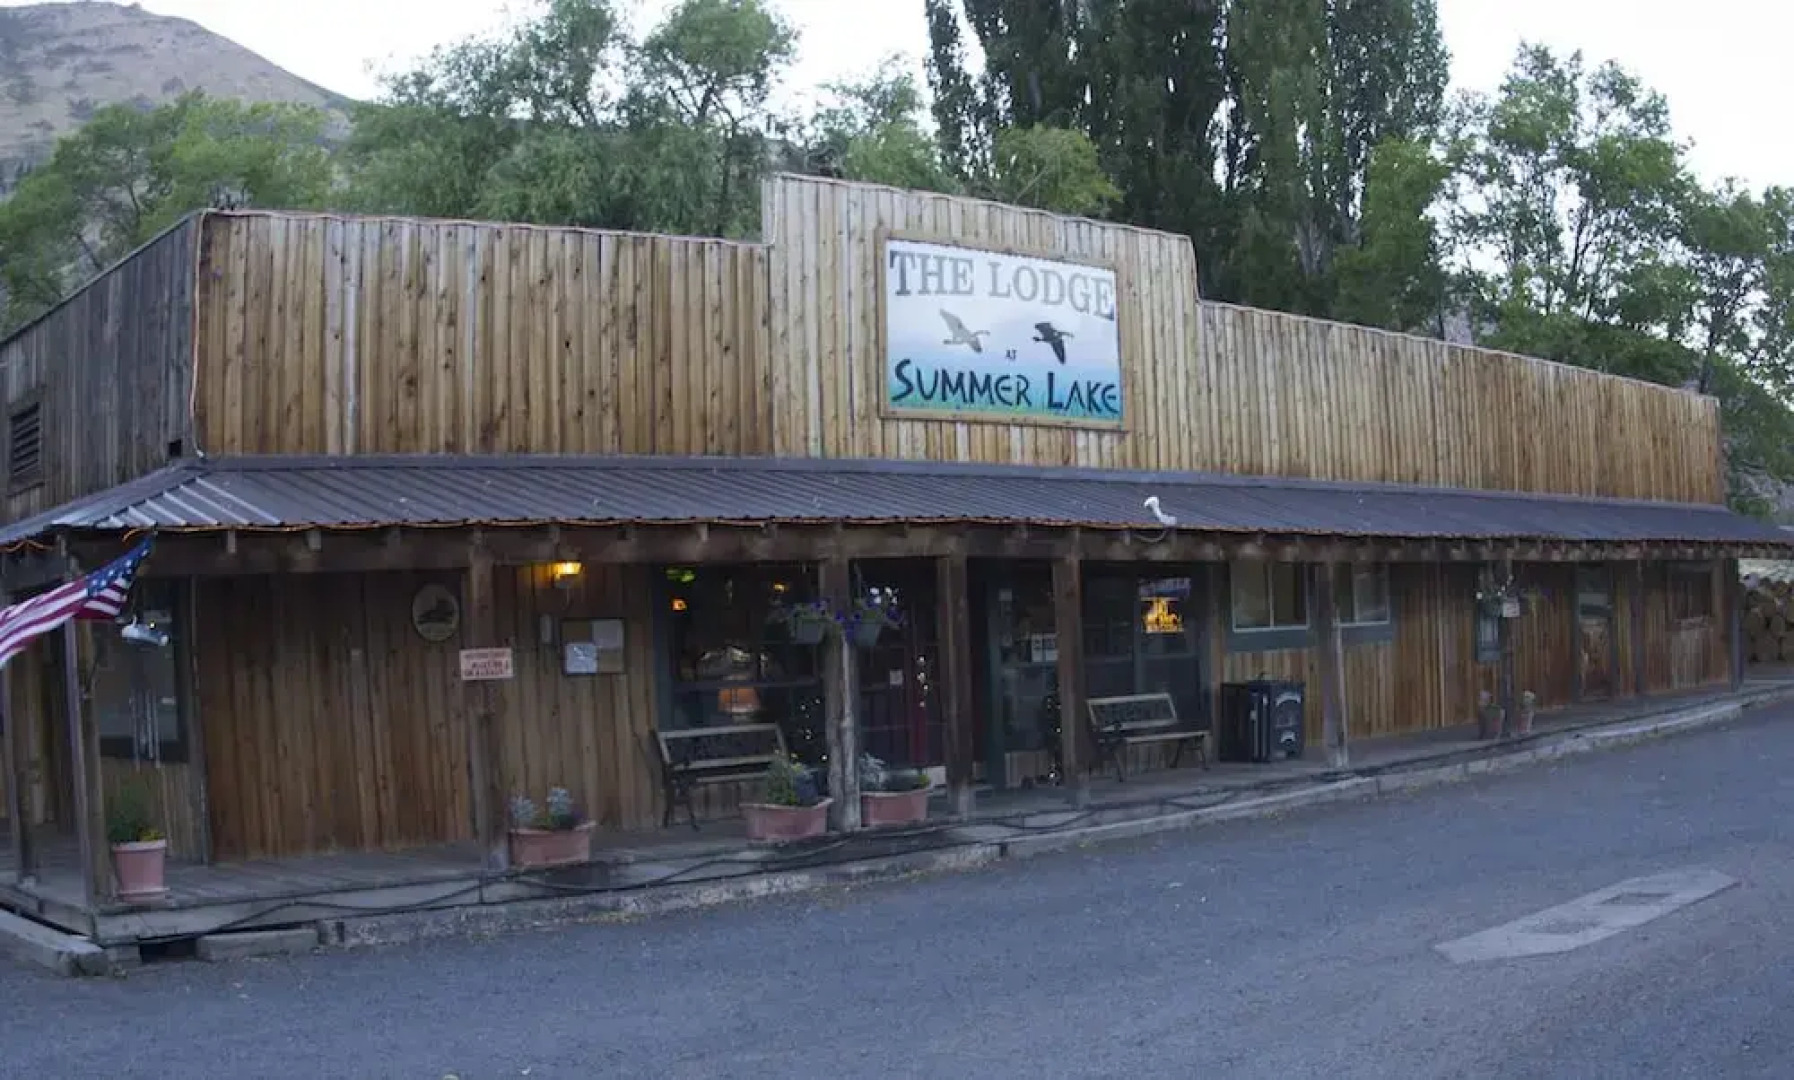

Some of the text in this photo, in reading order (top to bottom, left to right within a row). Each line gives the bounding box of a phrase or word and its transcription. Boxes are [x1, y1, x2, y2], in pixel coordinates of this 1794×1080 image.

[889, 250, 1115, 321] THE LODGE
[891, 358, 1120, 414] SUMMER LAKE
